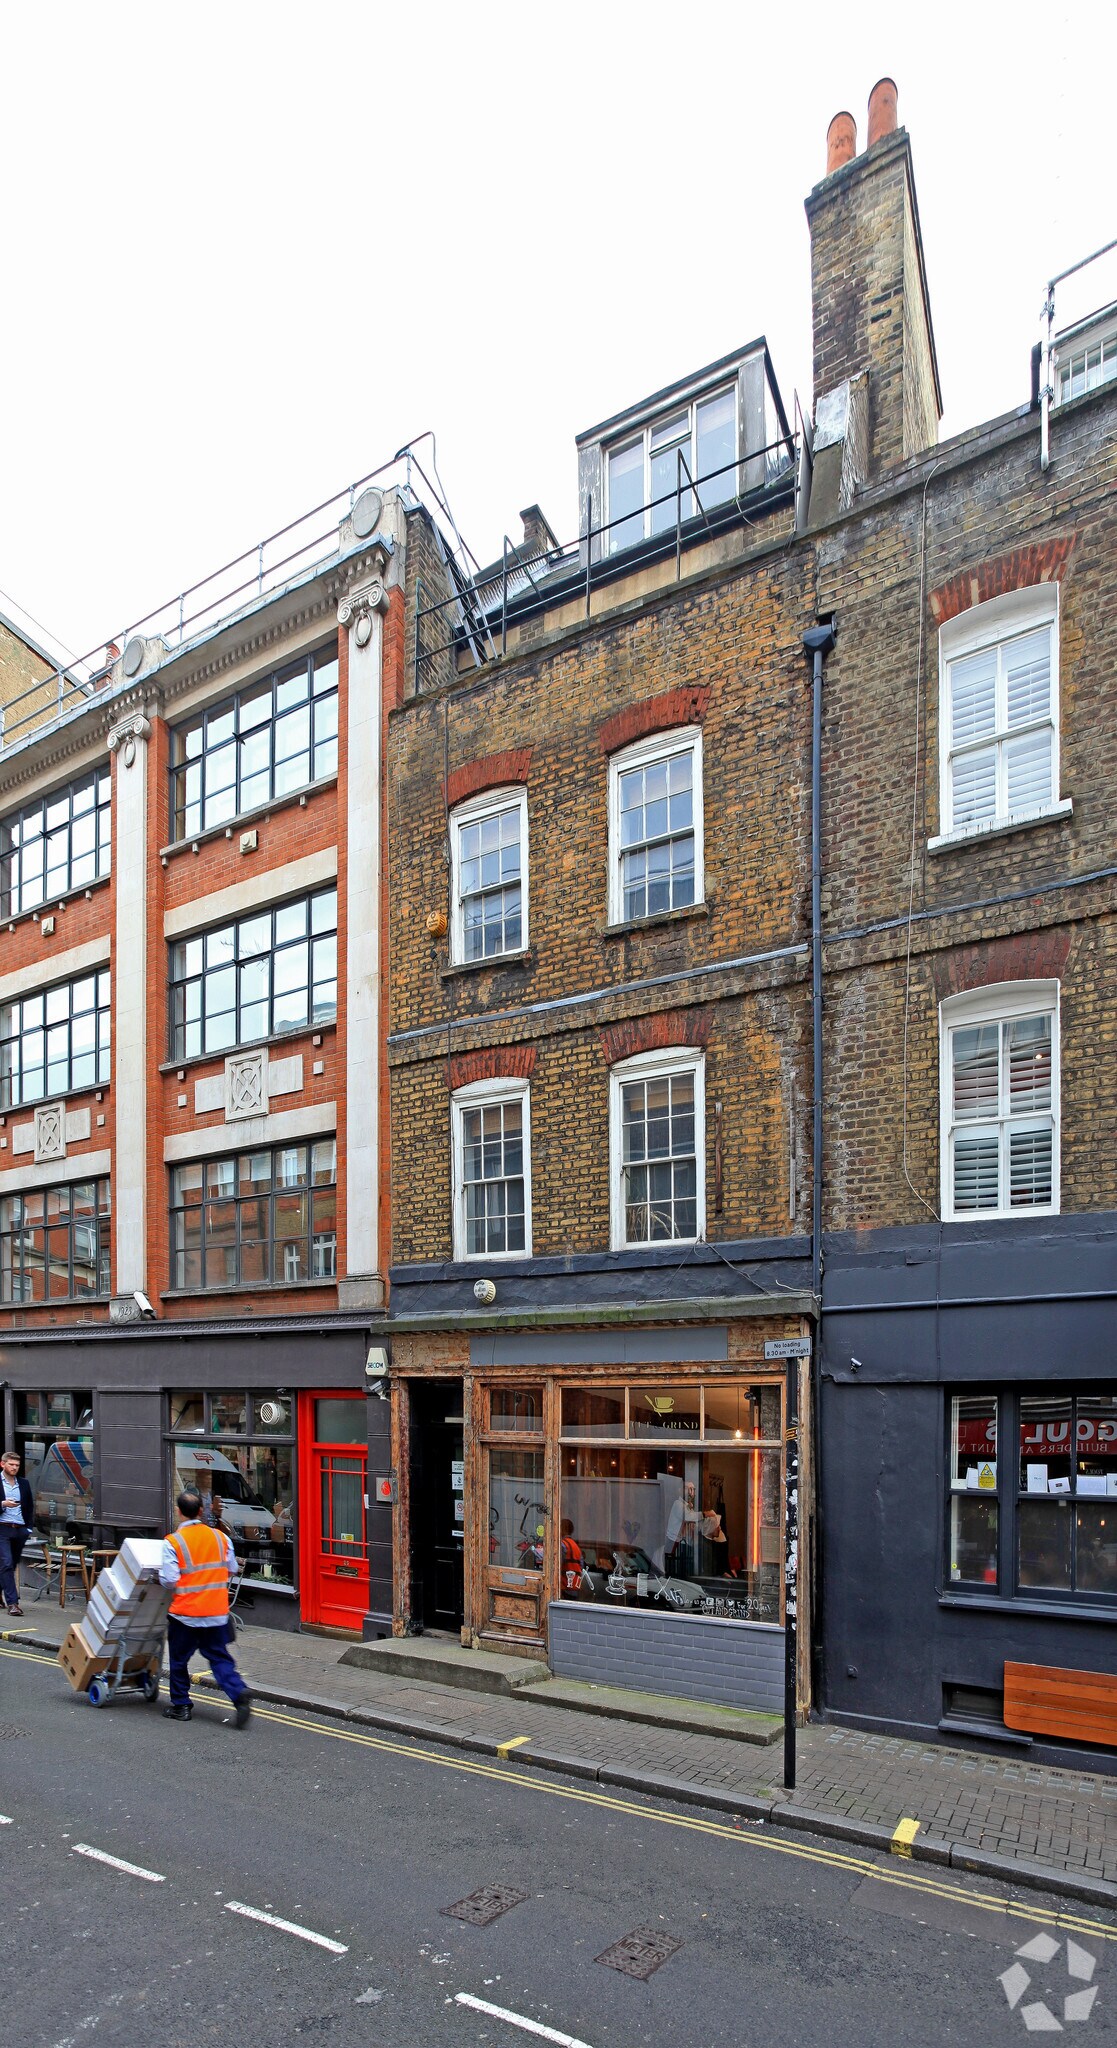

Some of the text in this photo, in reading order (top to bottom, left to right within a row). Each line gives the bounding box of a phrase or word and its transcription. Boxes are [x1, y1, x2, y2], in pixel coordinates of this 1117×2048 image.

[662, 1421, 698, 1429] GRIND
[747, 1598, 759, 1610] 20
[467, 1893, 508, 1911] METER
[616, 1939, 667, 1961] METER
